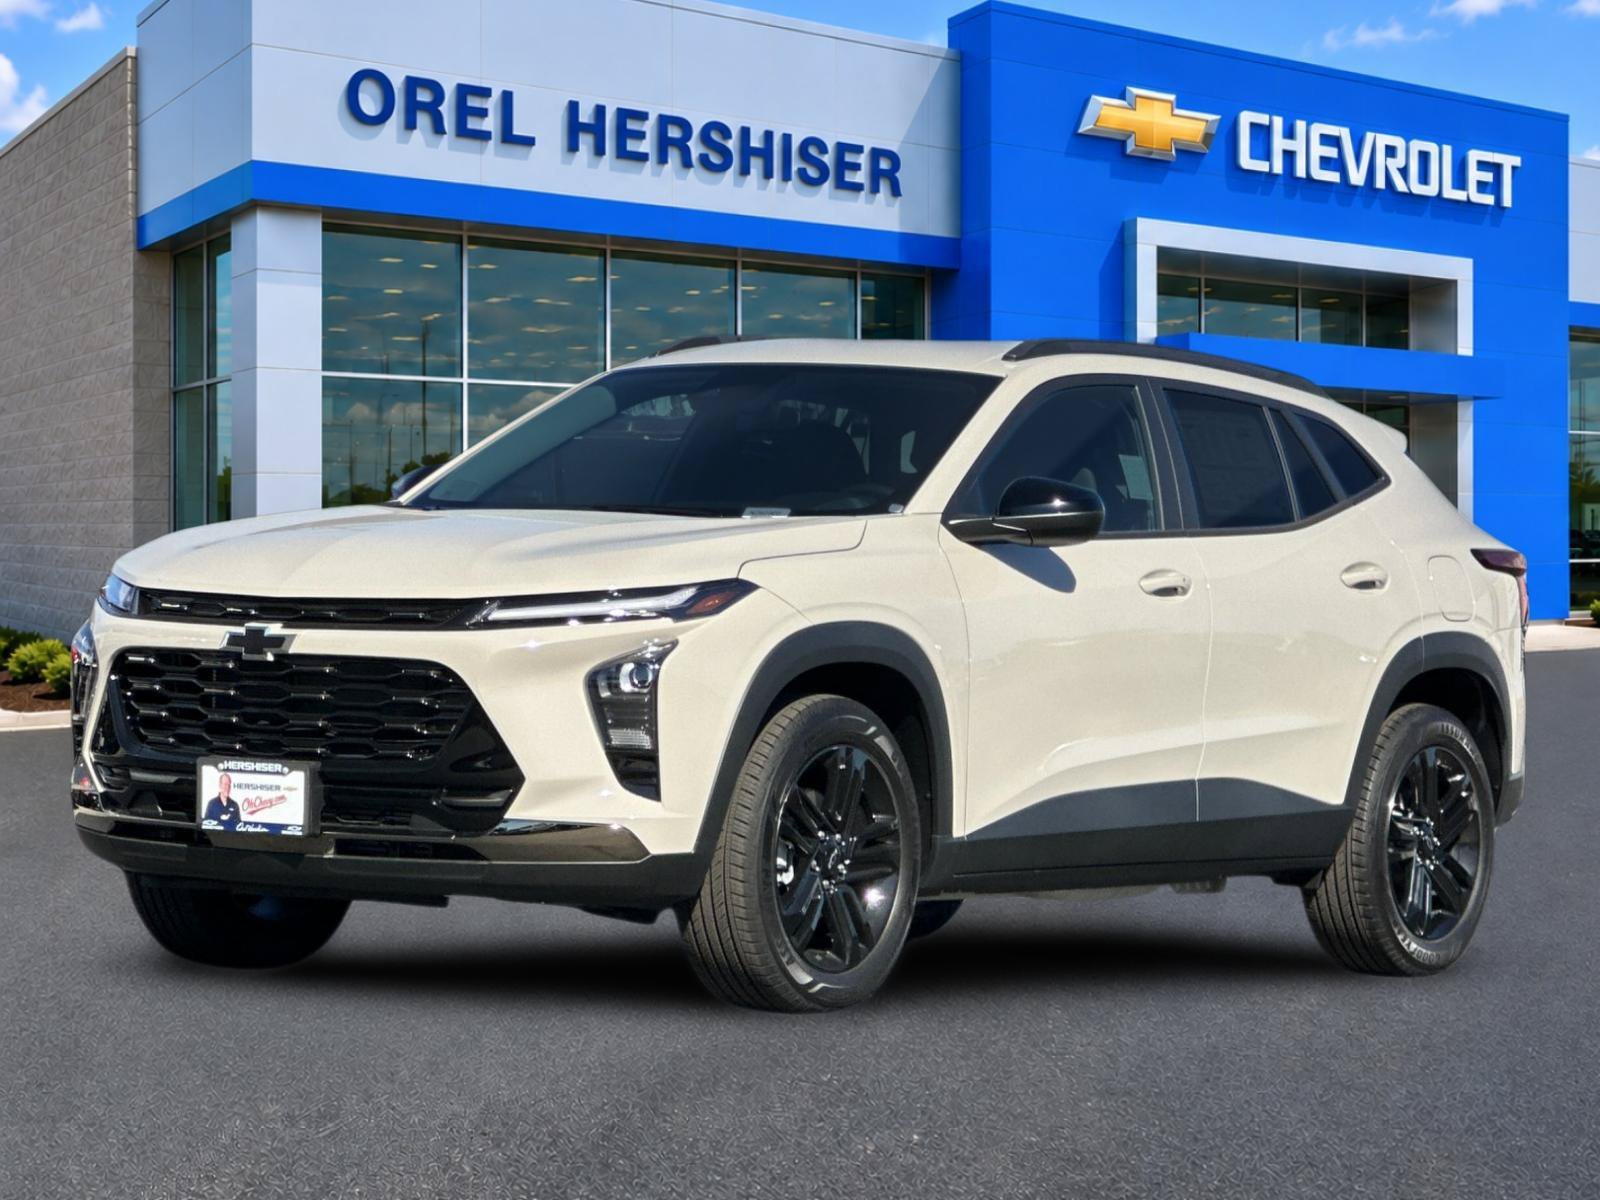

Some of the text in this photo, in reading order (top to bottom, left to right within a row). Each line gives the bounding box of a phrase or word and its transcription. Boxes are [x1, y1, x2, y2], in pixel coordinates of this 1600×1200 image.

[346, 68, 903, 198] OREL HERSHISER
[1236, 110, 1522, 208] CHEVROLET
[223, 761, 283, 773] HERSHISER
[233, 783, 281, 792] HERSHISER
